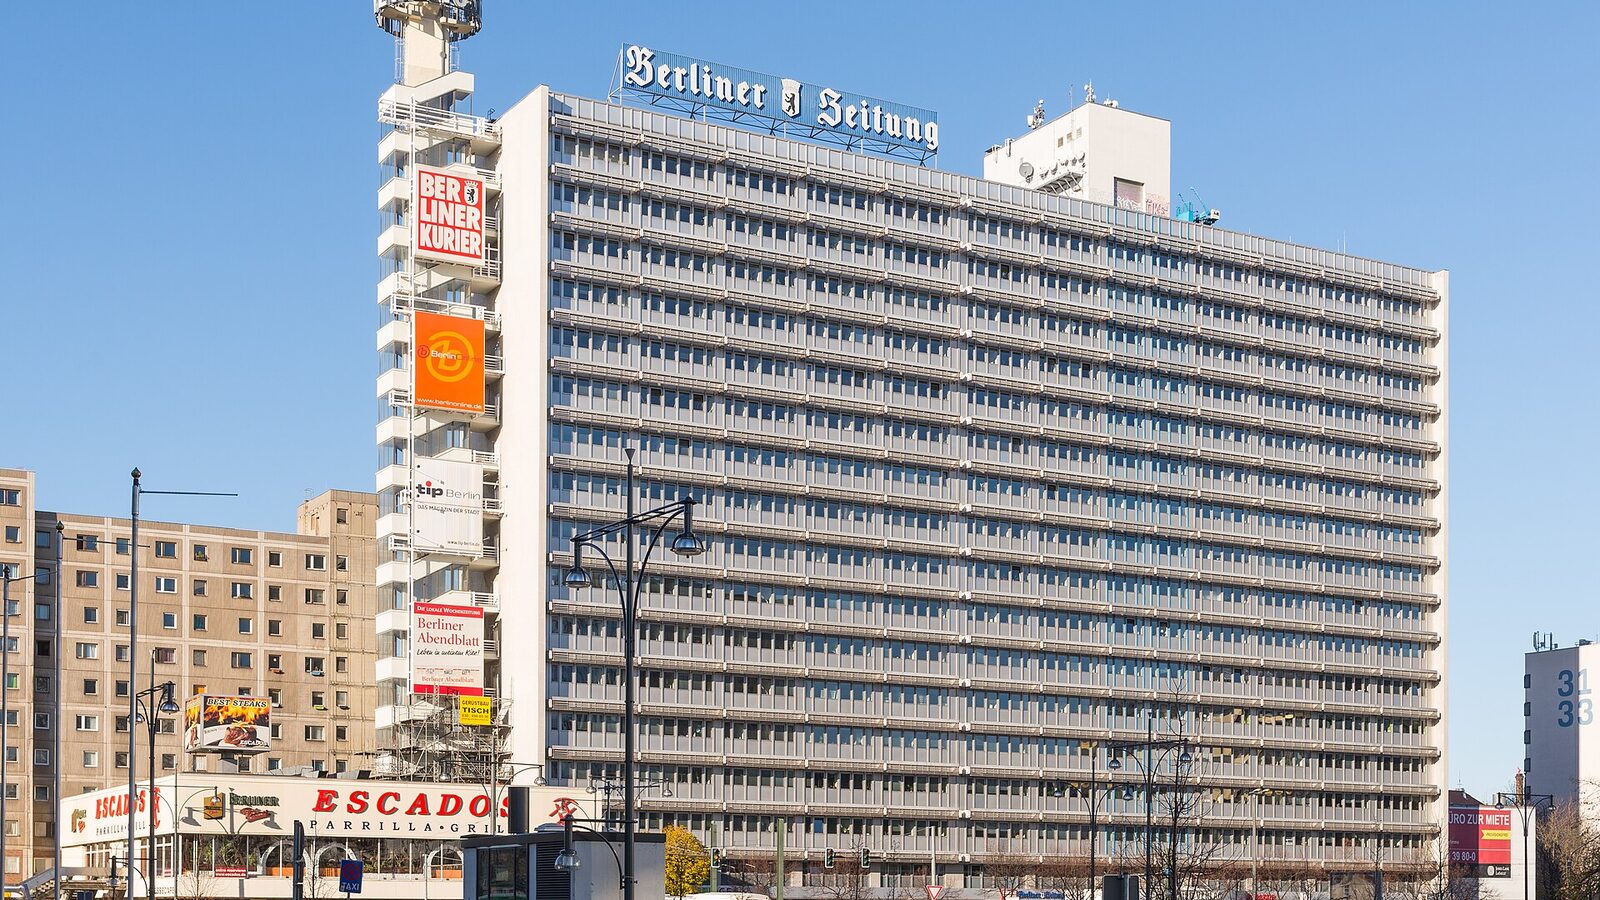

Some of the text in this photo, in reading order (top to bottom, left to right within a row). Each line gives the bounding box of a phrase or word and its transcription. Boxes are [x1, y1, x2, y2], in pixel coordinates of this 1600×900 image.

[624, 45, 939, 151] Berliner Zeitung
[420, 173, 461, 203] BER
[420, 198, 481, 230] LINER
[420, 223, 481, 255] KURIER
[417, 398, 482, 409] www.berlinonline.de
[416, 480, 481, 500] tip Berlin
[429, 505, 452, 513] MAGAZIN
[418, 617, 463, 631] Berliner
[417, 632, 479, 646] Abendblatt
[1558, 668, 1592, 697] 31
[207, 698, 231, 706] BEST
[232, 700, 267, 708] STEAKS
[1558, 698, 1593, 728] 33
[1449, 811, 1510, 826] ÜRO ZUR MIETE
[450, 823, 505, 833] GRIL
[1452, 851, 1476, 861] 39 80-0
